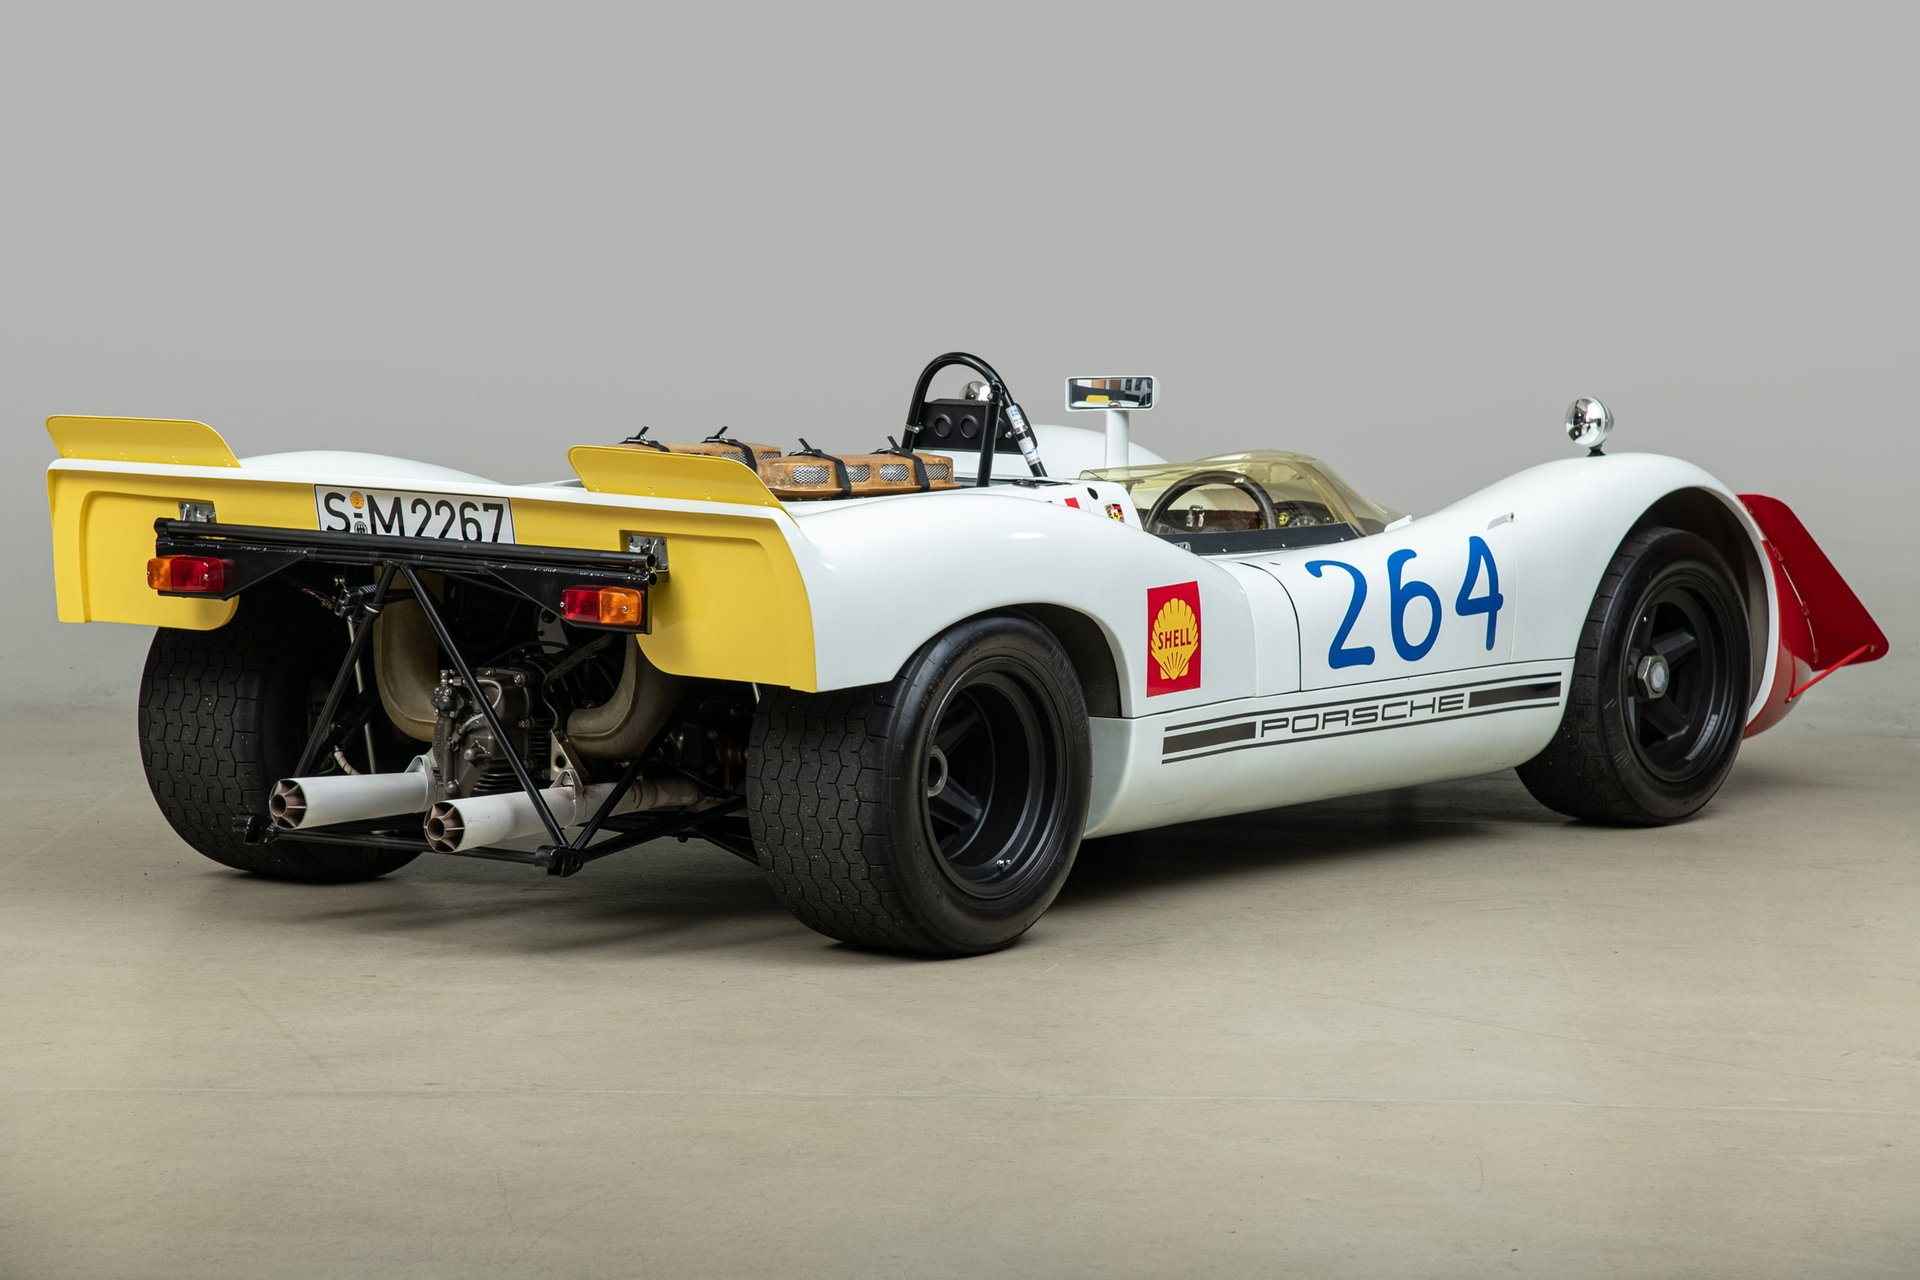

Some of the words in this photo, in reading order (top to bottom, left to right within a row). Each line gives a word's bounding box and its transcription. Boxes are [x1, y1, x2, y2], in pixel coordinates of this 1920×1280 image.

[1305, 536, 1504, 669] 264
[1158, 627, 1192, 651] SHELL
[1261, 693, 1465, 738] PORSCHE
